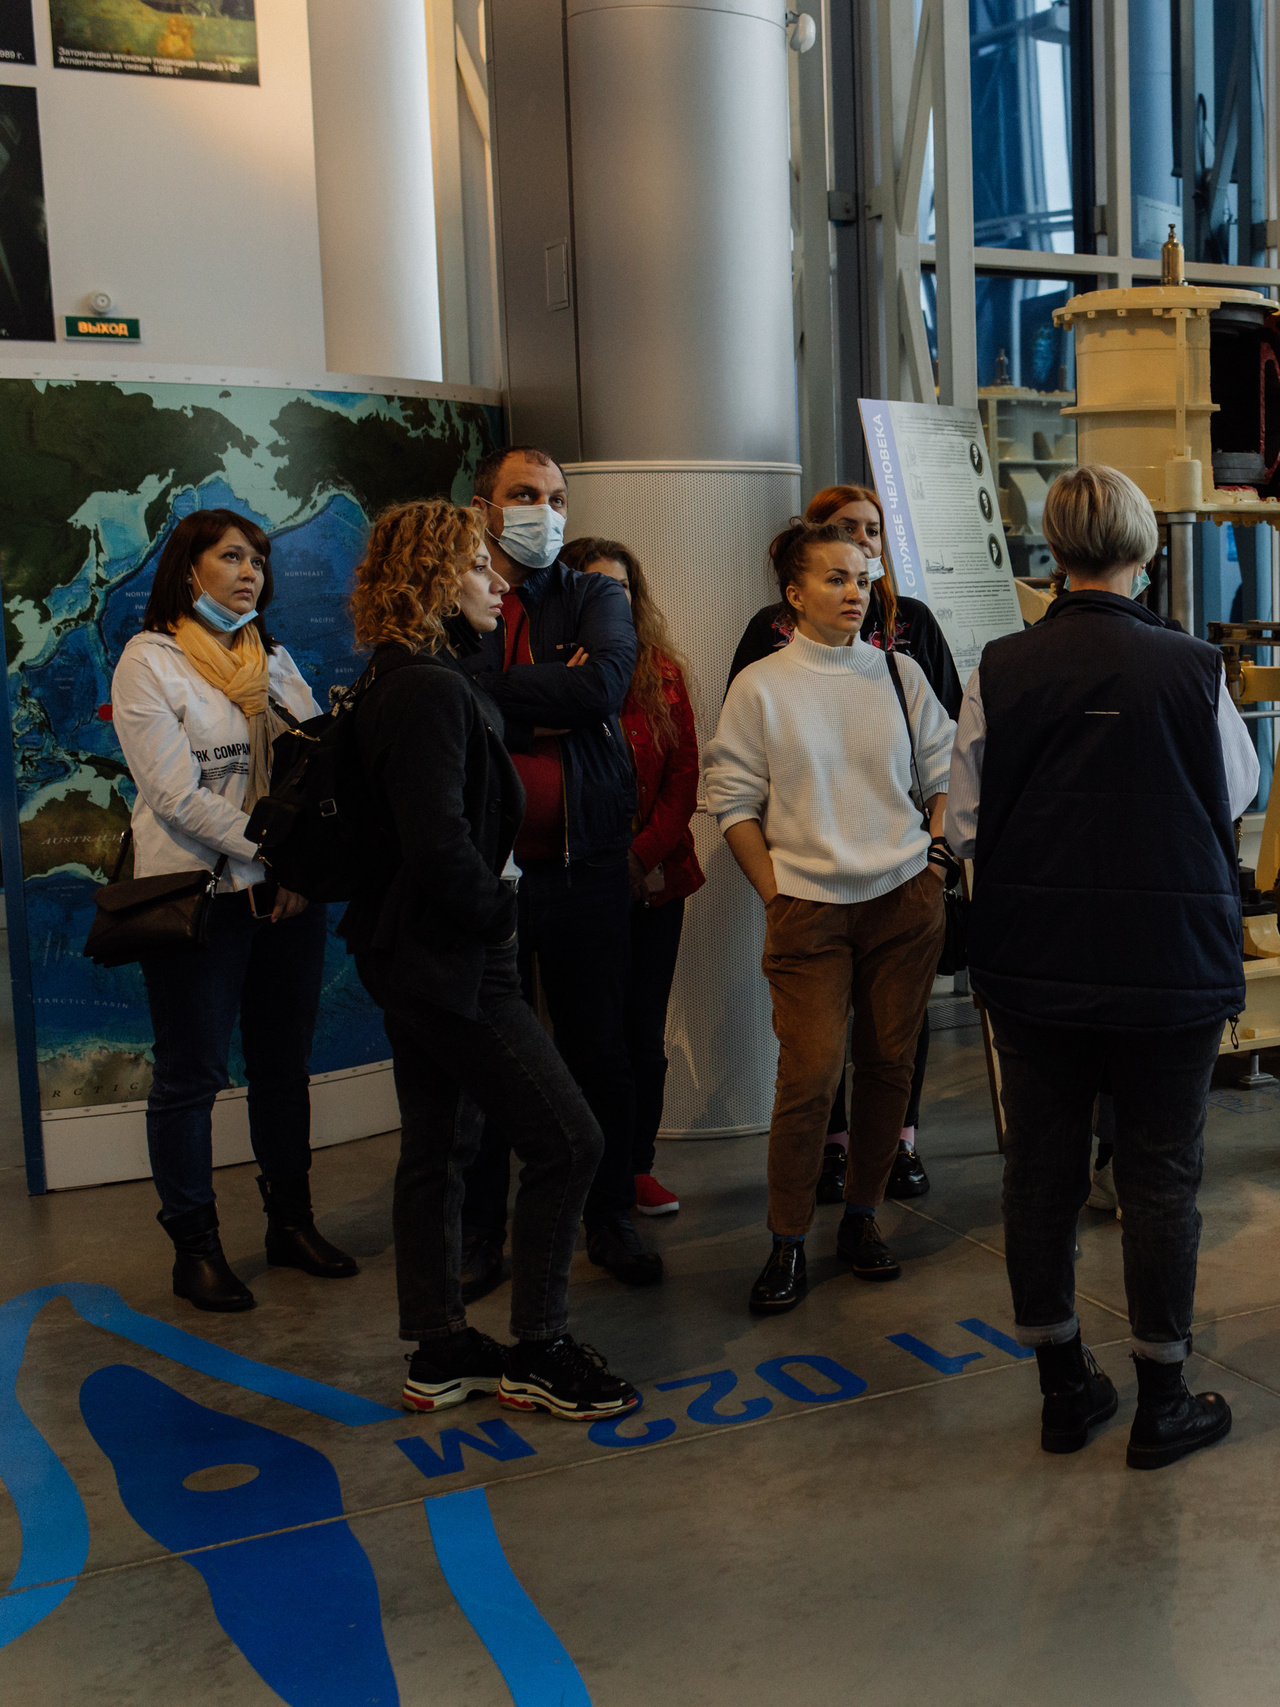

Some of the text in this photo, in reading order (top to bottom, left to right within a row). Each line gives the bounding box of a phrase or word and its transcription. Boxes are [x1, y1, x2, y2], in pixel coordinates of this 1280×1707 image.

[58, 46, 111, 61] Затонувшая
[58, 57, 123, 69] Атлантический
[77, 321, 129, 336] ВЫХОД
[872, 413, 917, 587] СЛУЖБЕ ЧЕЛОВЕКА
[94, 1000, 129, 1009] BASIN
